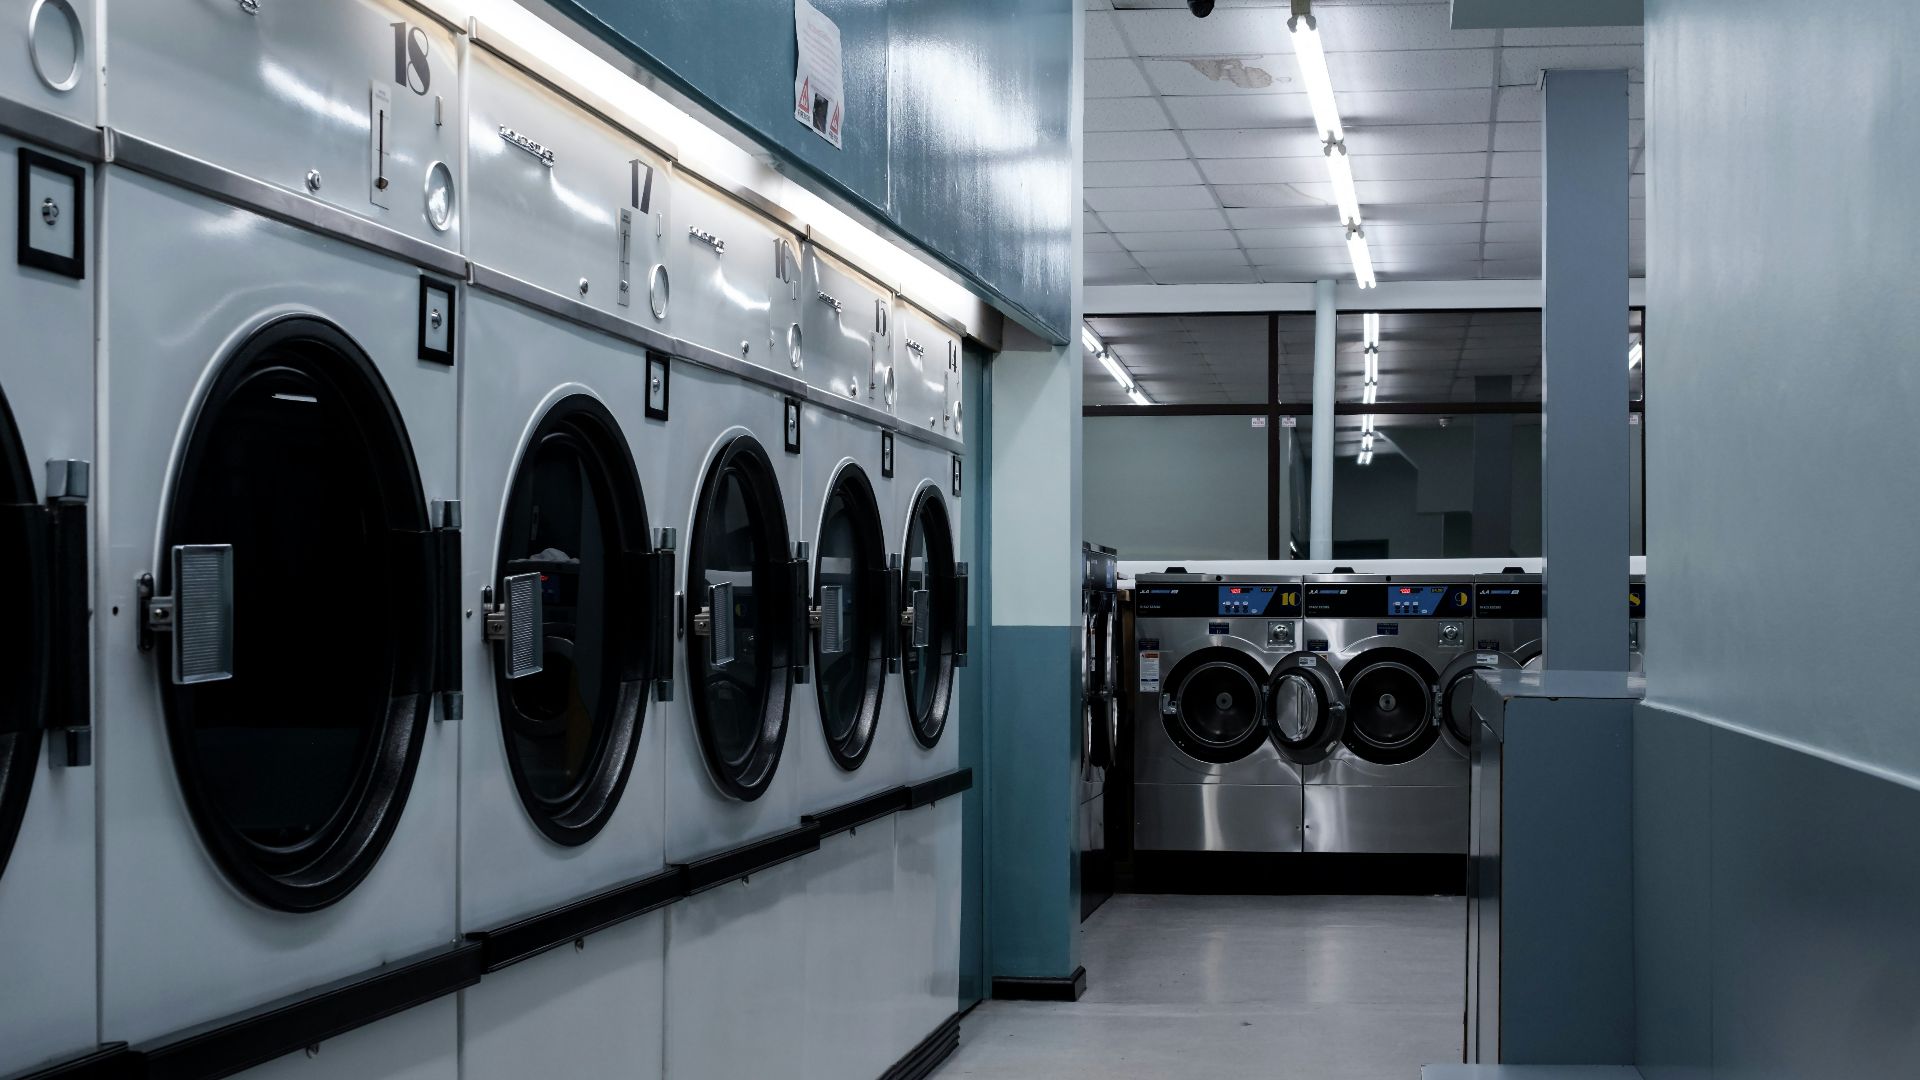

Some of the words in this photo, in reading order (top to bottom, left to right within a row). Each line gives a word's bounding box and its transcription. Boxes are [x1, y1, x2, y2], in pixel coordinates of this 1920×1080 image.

[390, 21, 431, 96] 18
[629, 159, 654, 214] 17
[773, 237, 791, 284] 16
[875, 298, 887, 337] 15
[947, 340, 958, 373] 14
[1280, 592, 1302, 607] 10
[1455, 591, 1468, 607] 9
